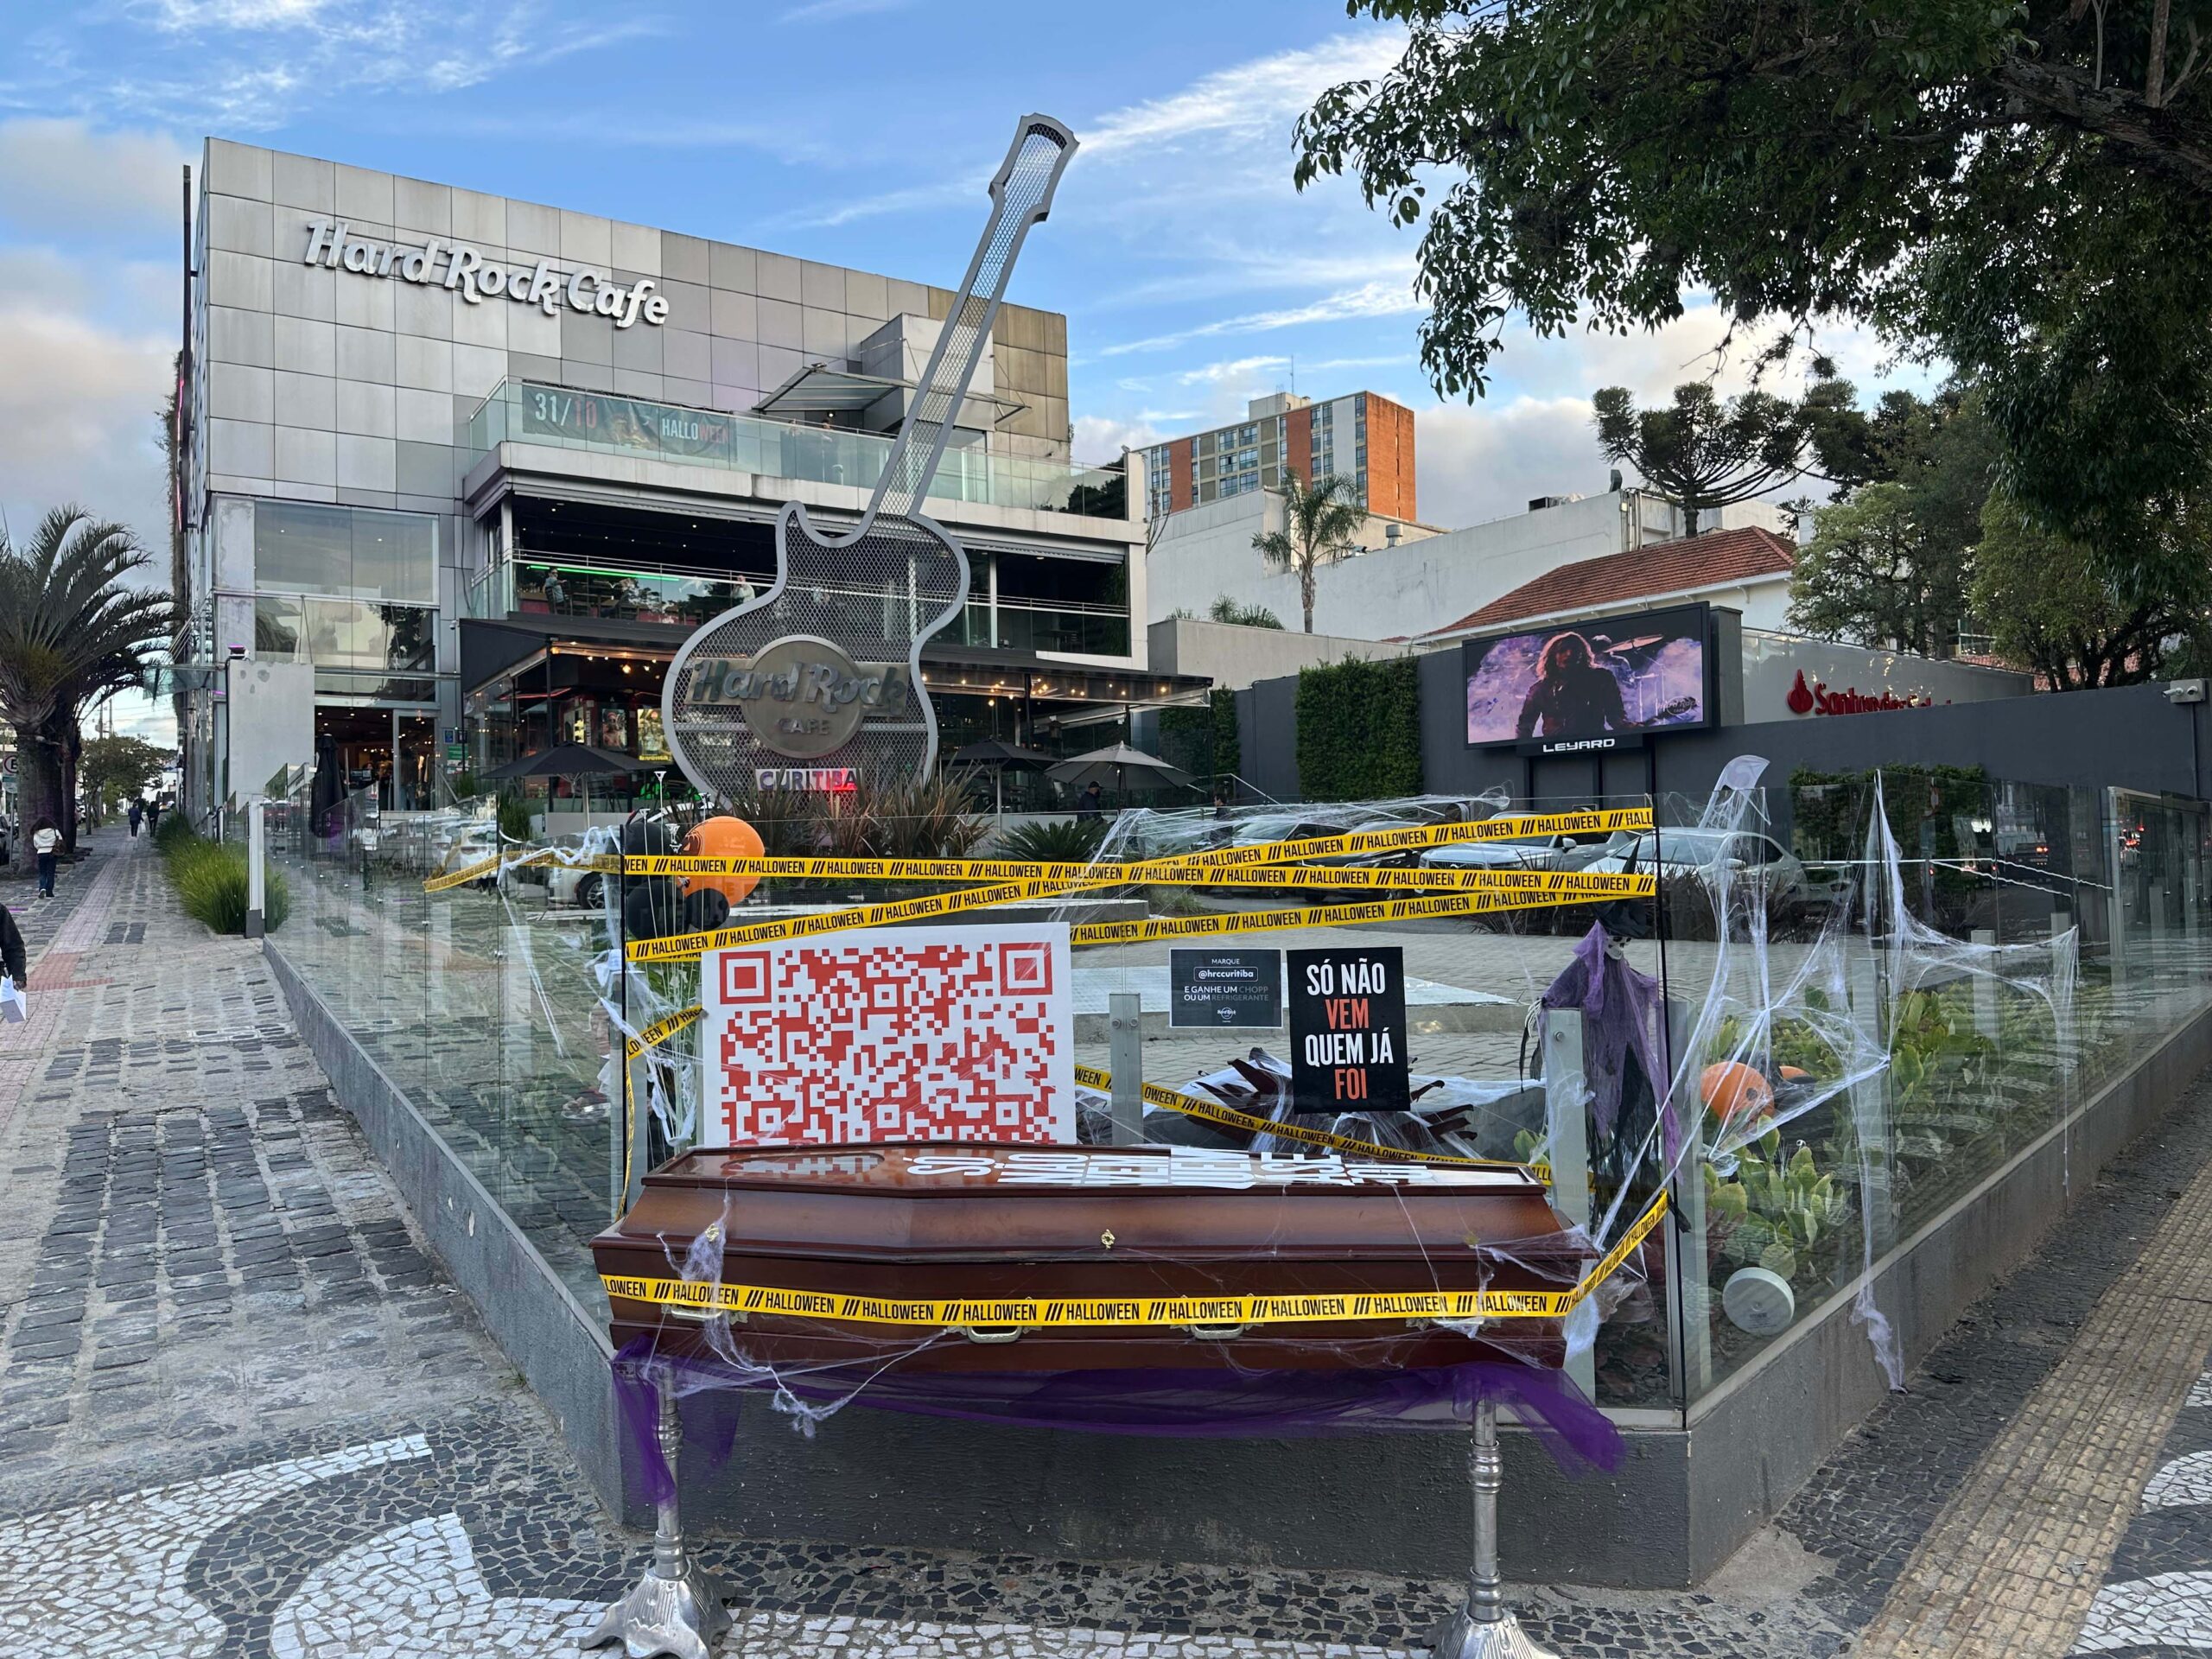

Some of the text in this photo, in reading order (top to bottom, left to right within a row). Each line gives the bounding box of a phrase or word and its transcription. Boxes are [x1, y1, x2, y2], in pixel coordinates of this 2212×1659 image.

[305, 219, 670, 328] Hard Rock Cafe
[535, 392, 728, 444] 31/10 HALLOWEEN
[692, 659, 907, 716] Hard Rock
[1542, 738, 1616, 753] LEYARD
[760, 769, 857, 791] CURITIBA
[1284, 838, 1344, 858] HALLOWEEN
[1368, 830, 1427, 849] HALLOWEEN
[1452, 822, 1513, 840] HALLOWEEN
[1538, 815, 1601, 833] HALLOWEEN
[670, 860, 727, 873] HALLOWEEN
[748, 861, 804, 874] HALLOWEEN
[827, 861, 884, 874] HALLOWEEN
[906, 863, 963, 876] HALLOWEEN
[985, 864, 1042, 877] HALLOWEEN
[1065, 866, 1122, 880] HALLOWEEN
[1145, 868, 1204, 881] HALLOWEEN
[1227, 869, 1286, 882] HALLOWEEN
[1310, 871, 1370, 884] HALLOWEEN
[1393, 872, 1455, 886] HALLOWEEN
[1478, 874, 1541, 887] HALLOWEEN
[1567, 875, 1630, 891] HALLOWEEN
[652, 936, 709, 955] HALLOWEEN
[730, 924, 787, 944] HALLOWEEN
[808, 912, 865, 931] HALLOWEEN
[886, 898, 943, 919] HALLOWEEN
[963, 885, 1021, 906] HALLOWEEN
[1080, 891, 1557, 941] HALLOWEEN HALLOWEEN HALLOWEEN HALLOWEEN HALLOWEEN HALLOWEEN
[1198, 969, 1254, 979] @hrccuritiba
[1306, 957, 1386, 995] SÓ NÃO
[1325, 998, 1370, 1029] VEM
[1305, 1027, 1394, 1067] QUEM JÁ
[1334, 1068, 1368, 1100] FOI
[1145, 1087, 1178, 1106] OWEEN
[1198, 1103, 1255, 1128] HALLOWEEN
[1277, 1126, 1336, 1145] HALLOWEEN
[766, 1294, 835, 1314] HALLOWEEN
[862, 1302, 934, 1320] HALLOWEEN
[963, 1303, 1037, 1321] HALLOWEEN
[1066, 1302, 1140, 1320] HALLOWEEN
[1169, 1301, 1243, 1319] HALLOWEEN
[1271, 1298, 1345, 1318] HALLOWEEN
[1374, 1295, 1448, 1313] HALLOWEEN
